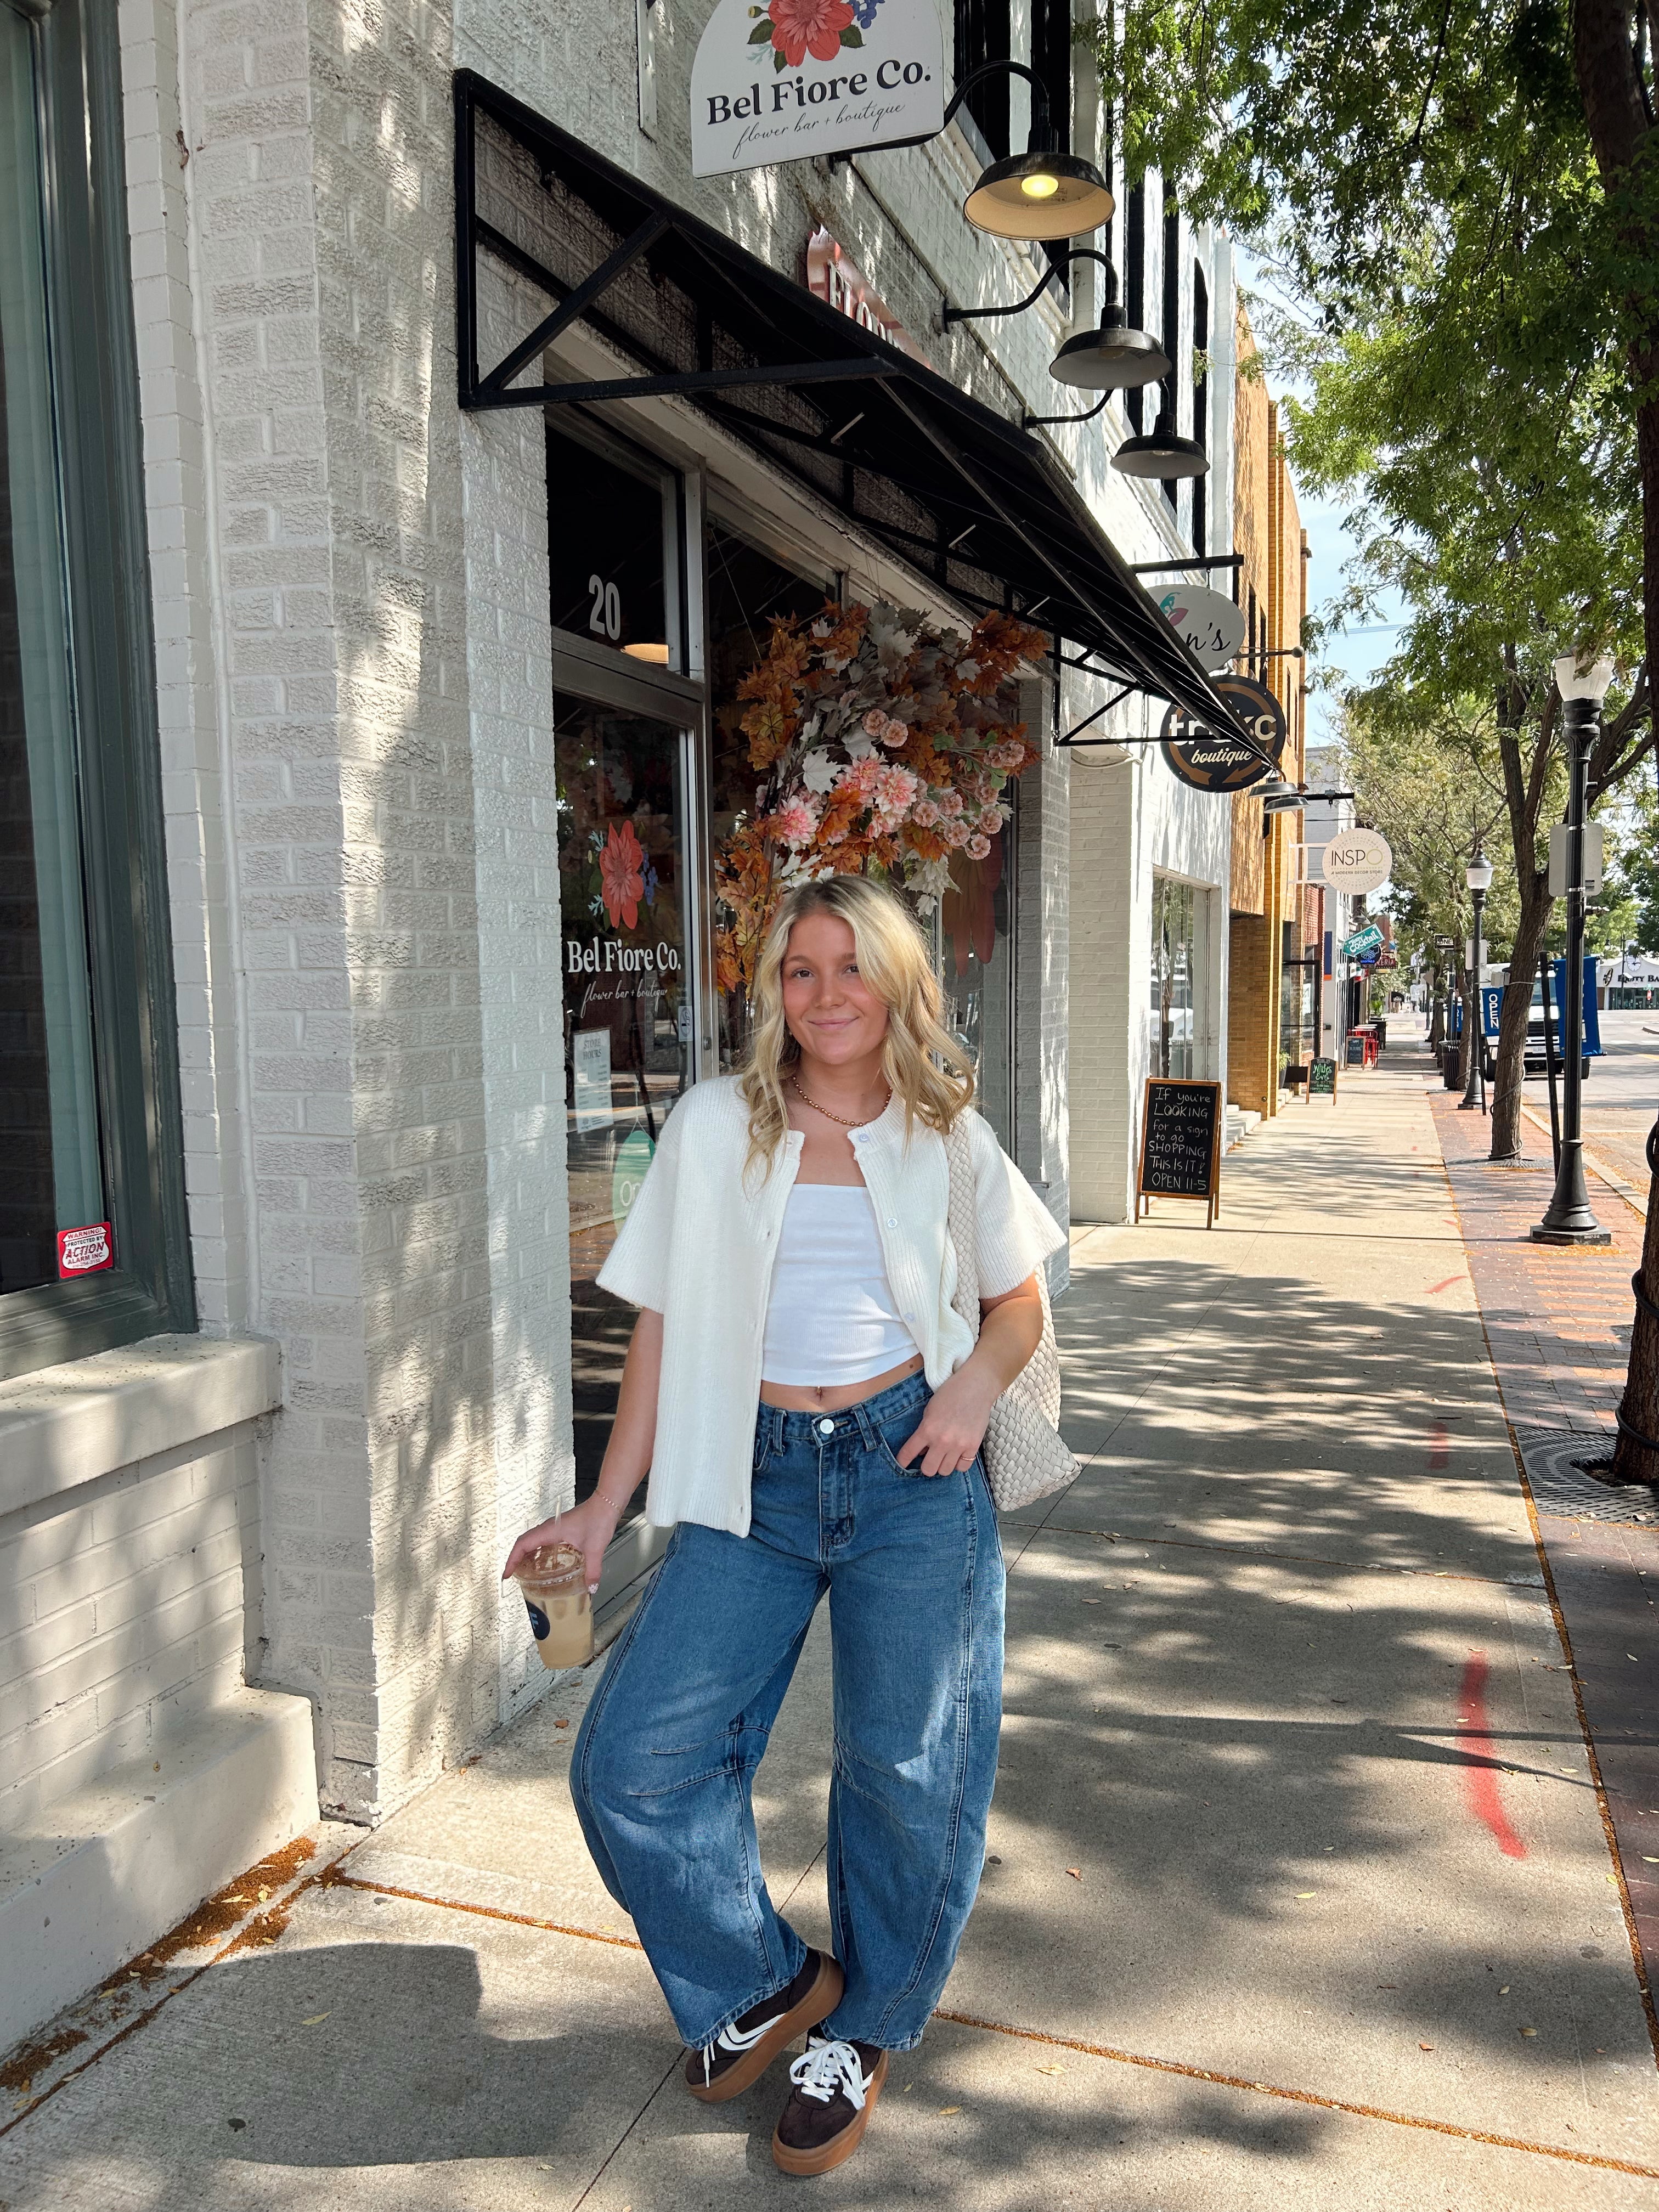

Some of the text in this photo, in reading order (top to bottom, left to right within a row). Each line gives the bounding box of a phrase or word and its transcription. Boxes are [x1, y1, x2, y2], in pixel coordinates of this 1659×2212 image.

[707, 60, 931, 126] Bel Fiore Co.
[733, 121, 789, 159] flower
[794, 112, 819, 133] bar
[836, 100, 906, 133] boutique
[589, 574, 620, 641] 20
[1191, 747, 1252, 767] boutique
[1331, 849, 1383, 866] INSPO
[567, 936, 681, 973] Bel Fiore Co.
[580, 981, 613, 1019] flower
[615, 980, 629, 1000] bar
[1489, 994, 1499, 1029] OPEN
[584, 1038, 601, 1049] STORE
[583, 1049, 601, 1060] HOURS
[1155, 1087, 1211, 1105] If you're
[1154, 1103, 1208, 1119] LOOKING
[1153, 1119, 1169, 1131] for
[1187, 1126, 1208, 1138] sign
[1155, 1131, 1184, 1145] to go
[1149, 1141, 1206, 1160] SHOPPING
[1149, 1155, 1171, 1169] THIS
[1152, 1172, 1206, 1190] OPEN 11-5
[67, 1228, 102, 1239] WARNING!
[67, 1237, 95, 1247] PROTECTED
[66, 1241, 105, 1259] ACTION
[67, 1255, 90, 1265] ALARM
